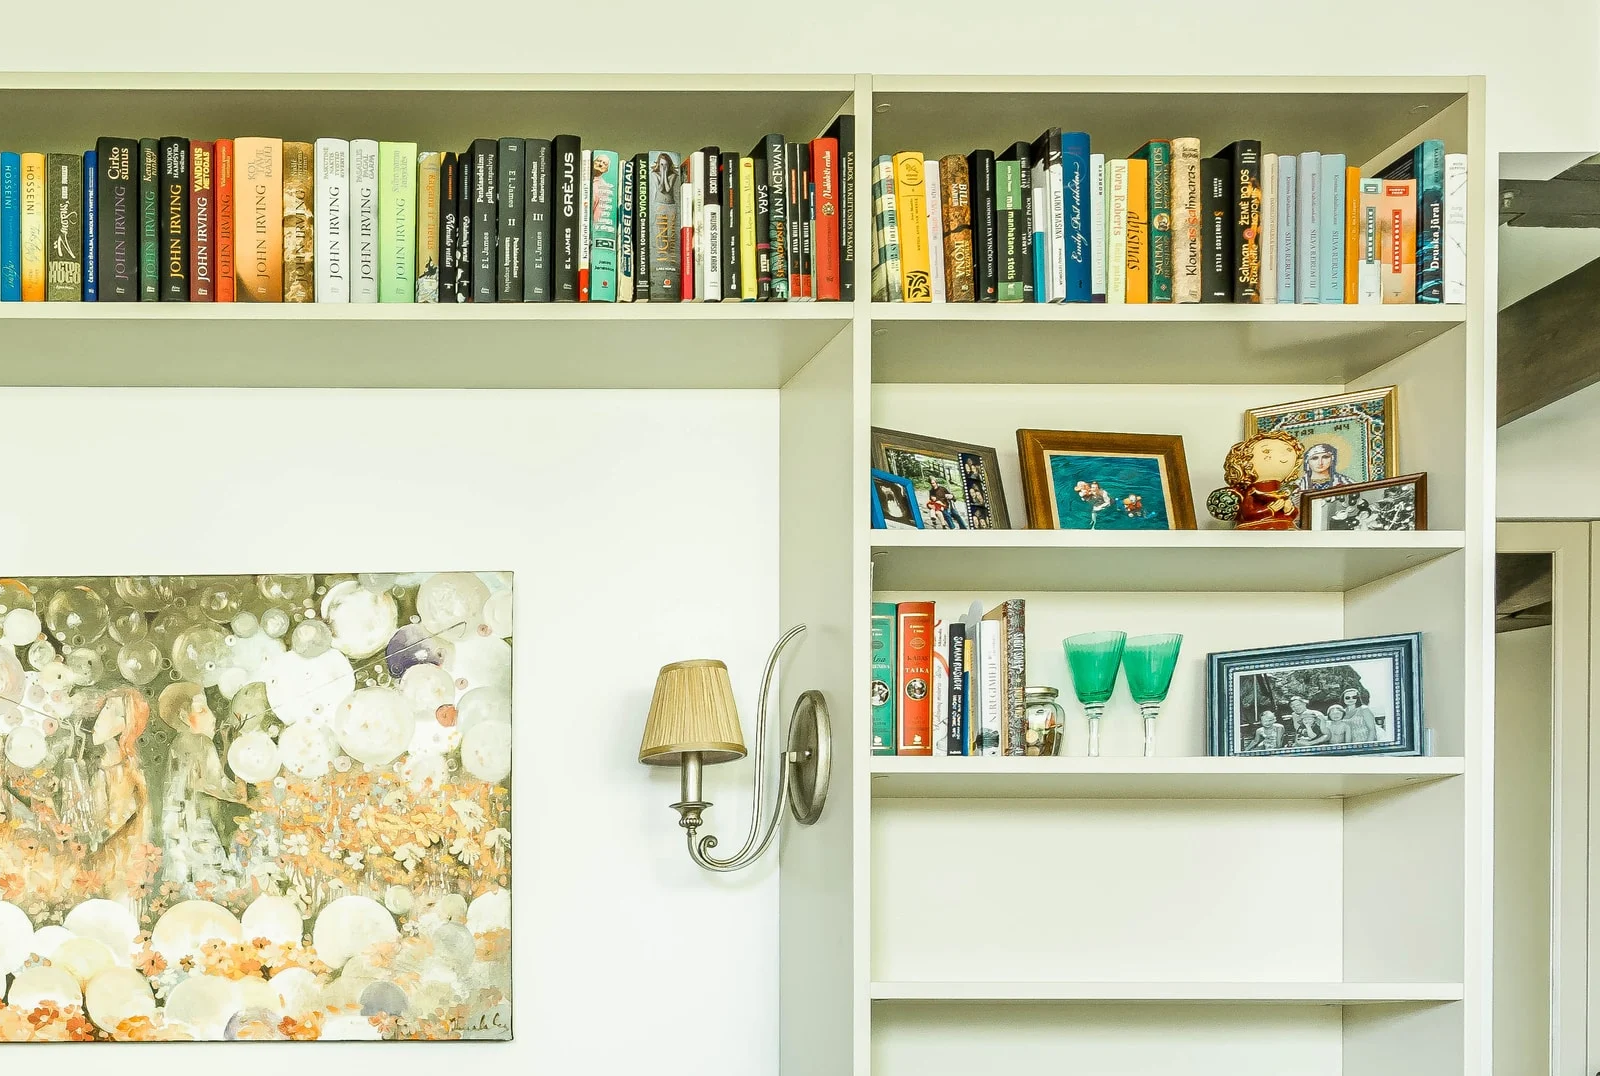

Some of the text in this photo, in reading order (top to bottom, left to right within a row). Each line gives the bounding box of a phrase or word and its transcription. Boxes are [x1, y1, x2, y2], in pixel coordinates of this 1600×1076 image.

[27, 165, 35, 215] HOSSEINI
[108, 147, 119, 180] Cirko
[194, 148, 203, 192] VANDENS
[562, 152, 574, 217] GRĖJUS
[959, 183, 968, 206] BILL
[170, 184, 184, 279] JOHN IRVING
[256, 185, 270, 278] JOHN IRVING
[639, 181, 647, 218] KEROUAC
[757, 184, 768, 214] SARA
[774, 198, 784, 218] IAN
[1113, 166, 1126, 235] Nora Roberts
[1185, 165, 1198, 276] Klounas Šalimaras
[1238, 201, 1250, 225] ŽEMĖ
[115, 186, 128, 280] JOHN IRVING
[145, 191, 158, 279] JOHN IRVING
[197, 197, 210, 282] JOHN IRVING
[221, 194, 232, 279] JOHN IRVING
[295, 190, 308, 282] JOHN IRVING
[329, 186, 342, 280] JOHN IRVING
[361, 188, 374, 281] JOHN IRVING
[396, 198, 407, 281] JOHN IRVING
[535, 231, 543, 255] James
[845, 230, 853, 261] PASAULĮ
[954, 241, 964, 277] IKONA
[1007, 211, 1015, 280] manhatano stotis
[1069, 206, 1088, 263] Emily Post
[1154, 235, 1163, 275] SALMAN
[1239, 244, 1250, 283] Salman
[1430, 203, 1440, 269] Druska jūrai
